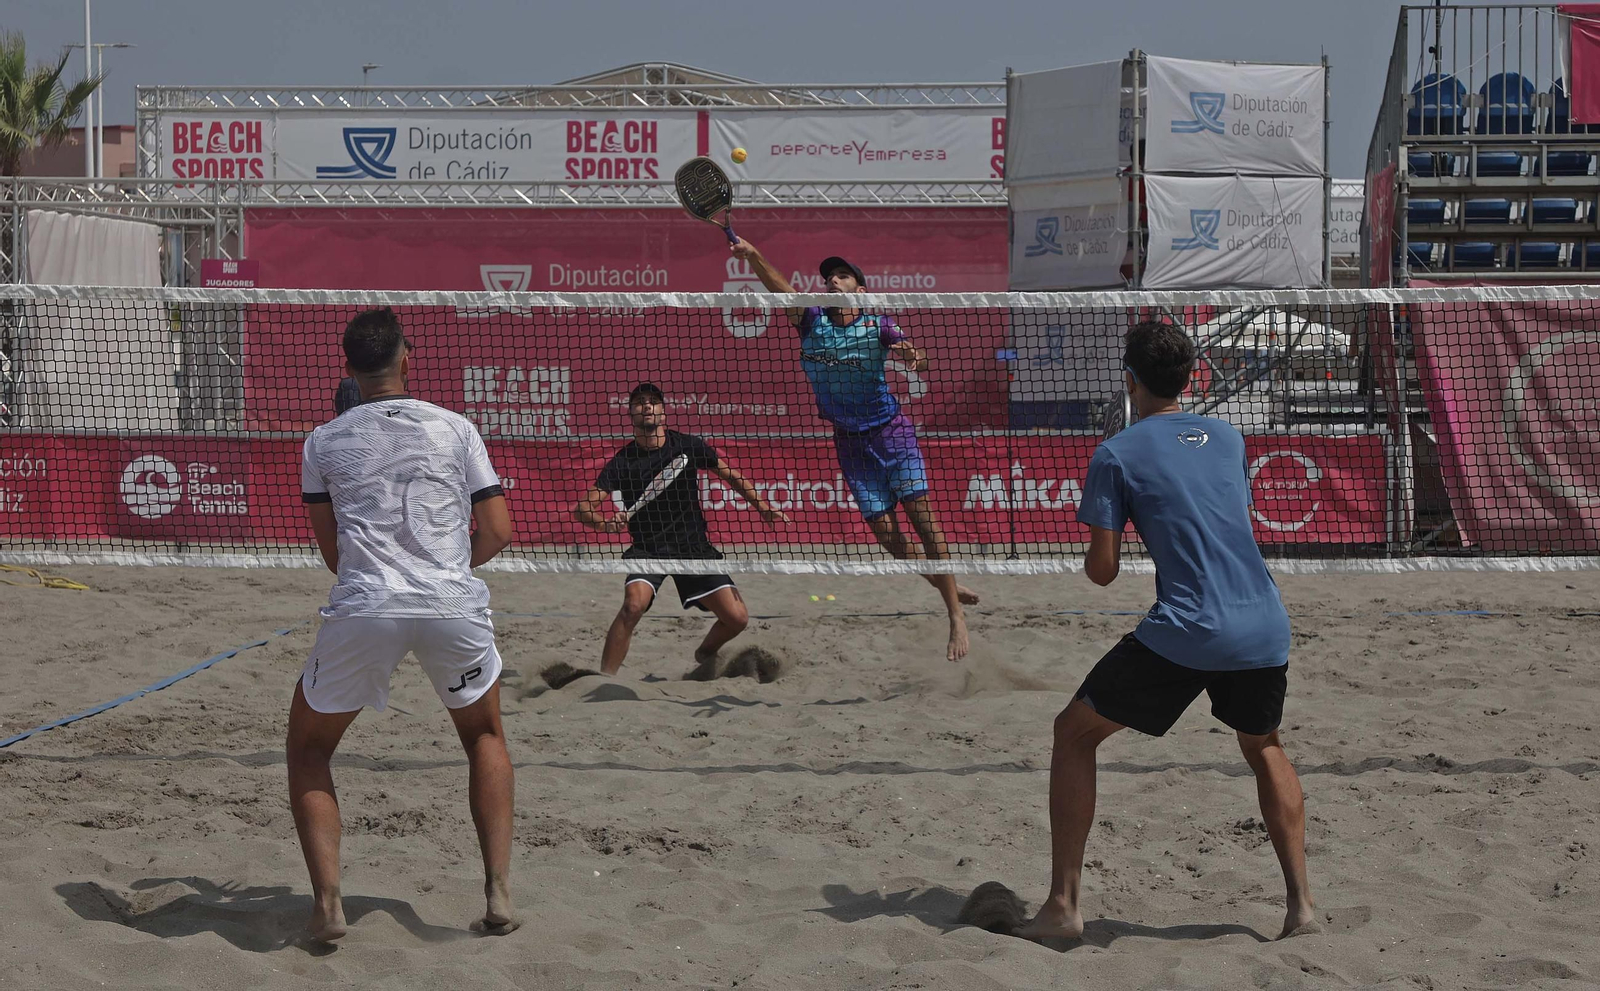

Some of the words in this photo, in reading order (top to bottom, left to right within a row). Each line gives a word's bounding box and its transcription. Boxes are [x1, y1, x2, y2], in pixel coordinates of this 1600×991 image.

[1233, 93, 1307, 114] Diputación
[173, 121, 262, 154] BEACH
[409, 127, 532, 154] Diputación
[566, 120, 658, 153] BEACH
[1232, 119, 1250, 136] de
[1256, 119, 1294, 138] Cádiz
[172, 158, 264, 189] SPORTS
[409, 160, 435, 180] de
[446, 160, 510, 180] Cádiz
[565, 157, 659, 188] SPORTS
[1064, 213, 1115, 233] Diputación
[1227, 209, 1302, 229] Diputación
[1227, 235, 1244, 251] de
[1250, 233, 1288, 249] Cádiz
[549, 264, 668, 289] Diputación
[790, 270, 936, 293] Ayumiento
[463, 366, 570, 404] BEACH
[187, 479, 244, 495] Beach
[697, 473, 859, 511] berdrol
[963, 460, 1083, 509] MIKA
[187, 496, 247, 514] Tennis
